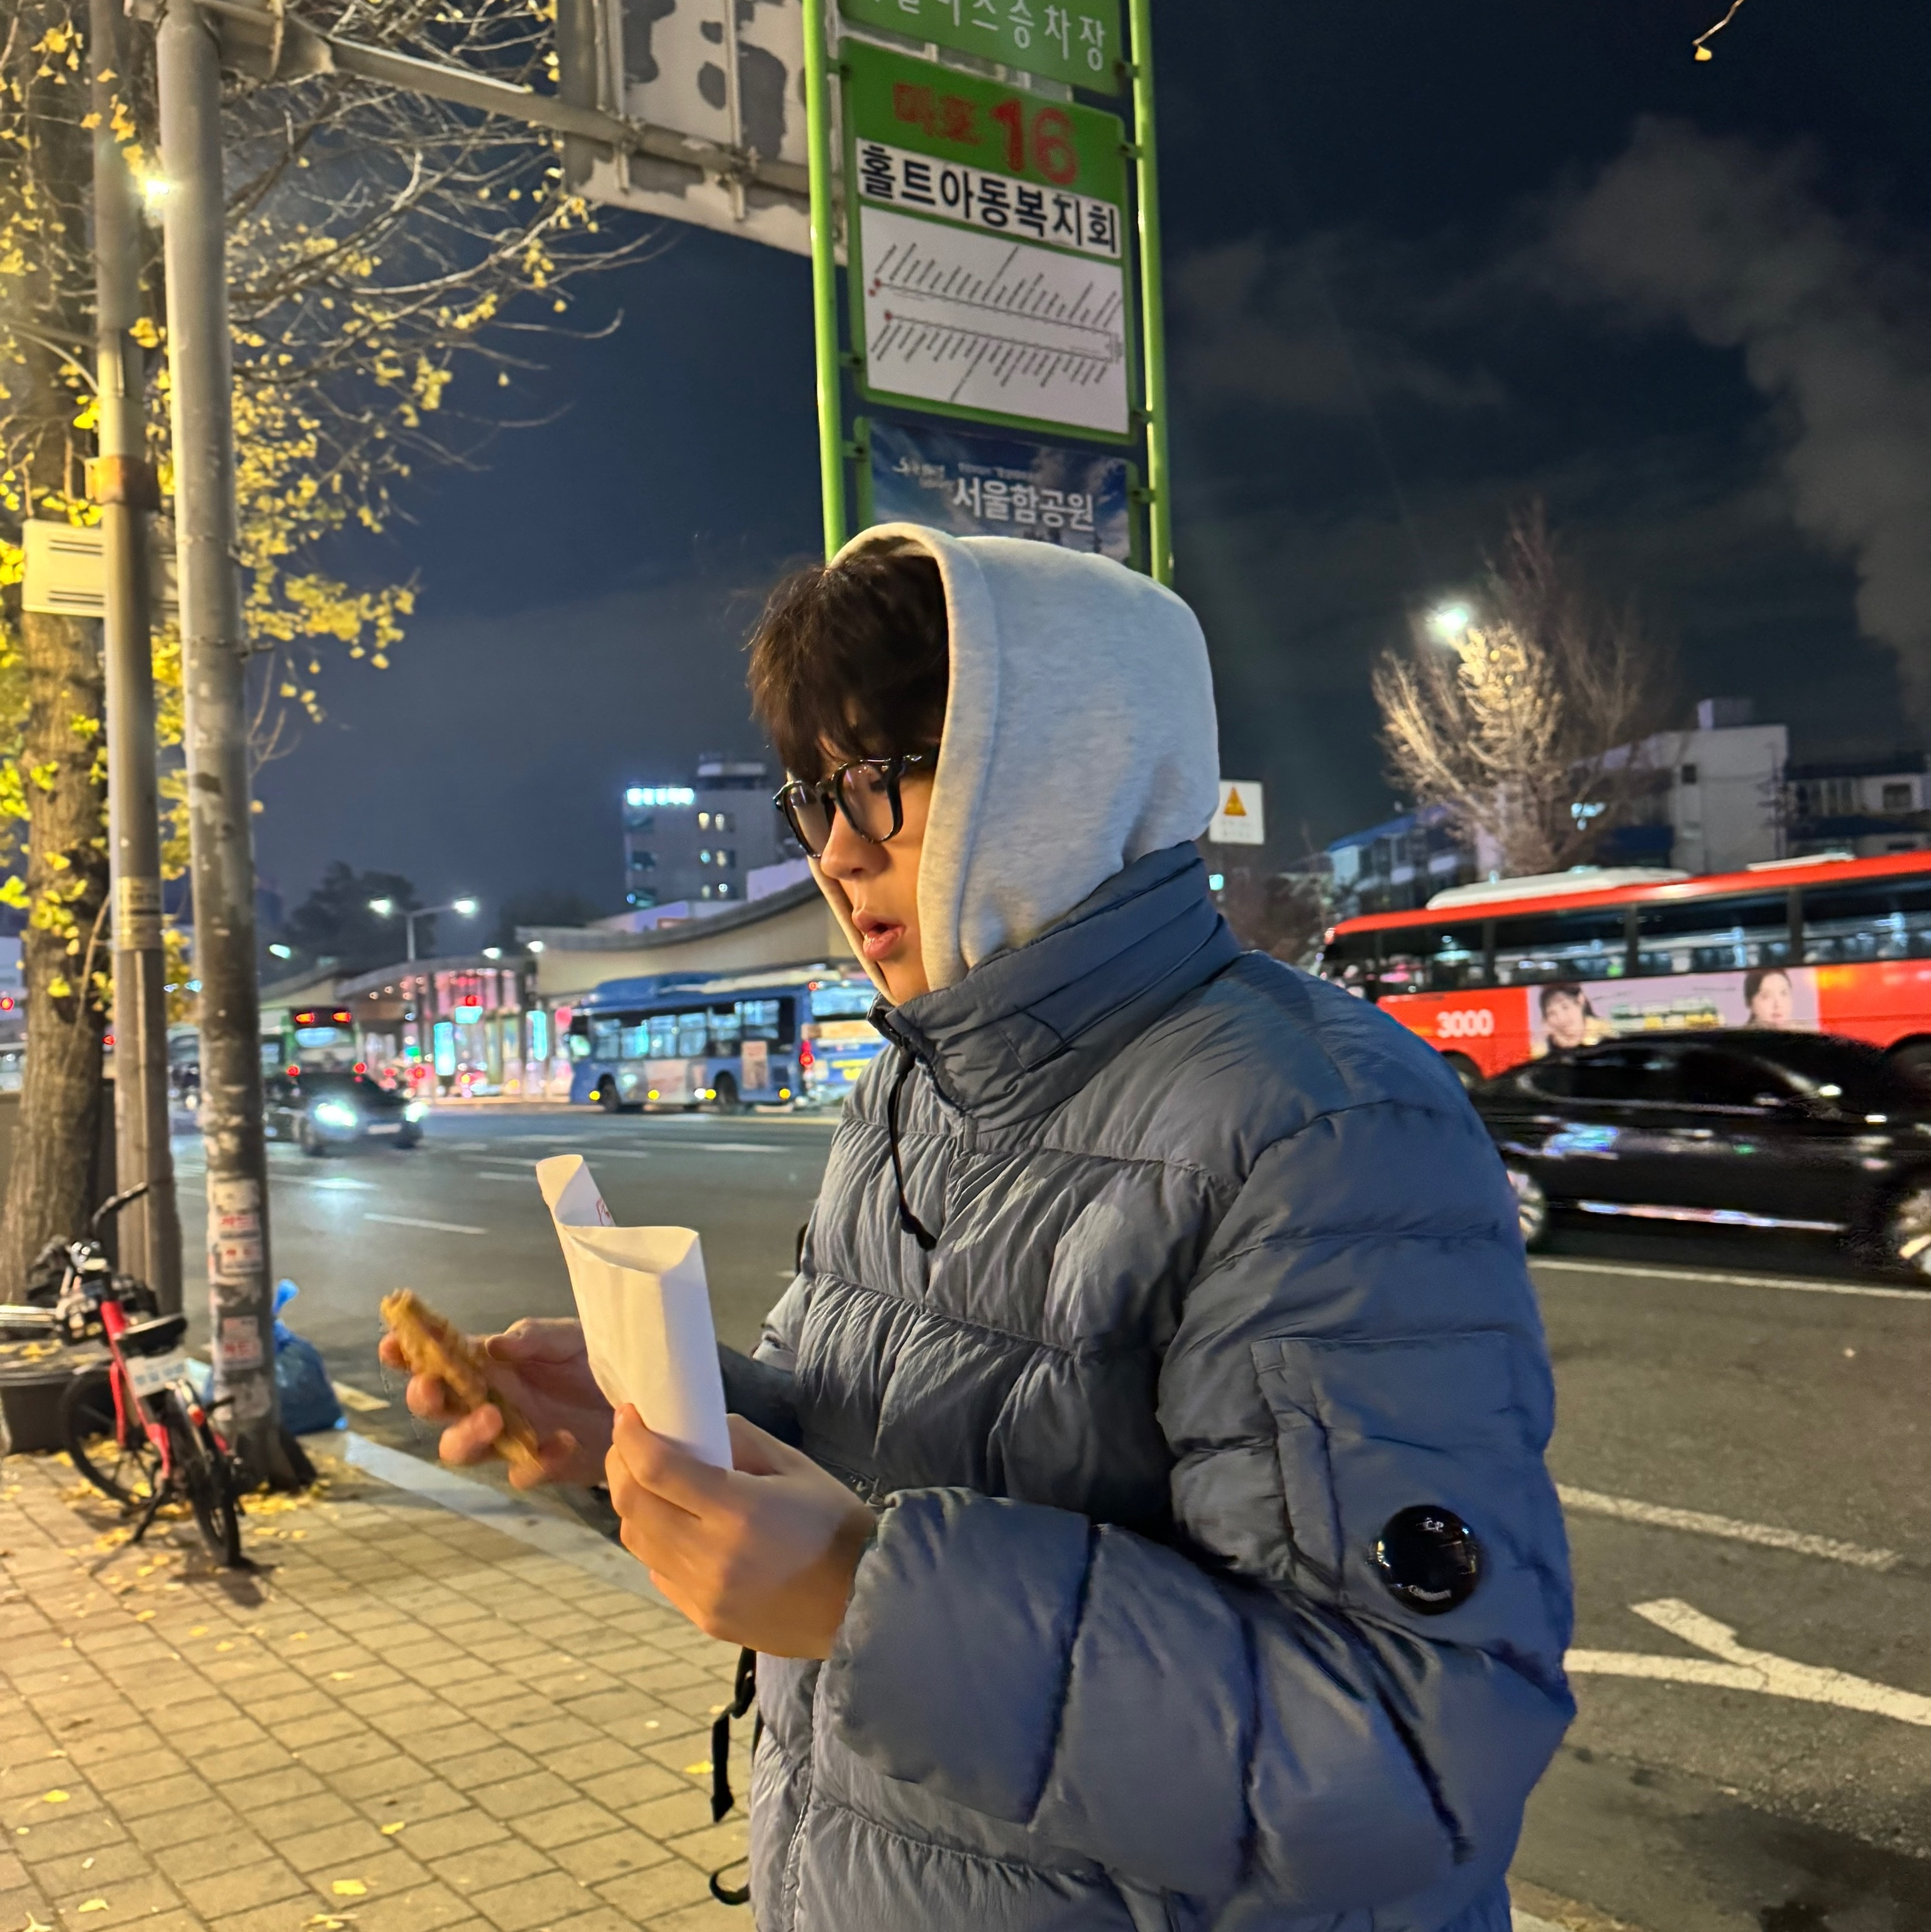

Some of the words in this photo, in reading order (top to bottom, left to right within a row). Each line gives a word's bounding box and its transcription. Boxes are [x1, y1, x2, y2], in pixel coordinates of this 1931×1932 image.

[876, 0, 1105, 70] 스승차장
[989, 98, 1078, 185] 16
[861, 145, 1116, 254] 홀트아동복지회
[953, 477, 1094, 532] 서울함공원
[1436, 1009, 1494, 1039] 3000
